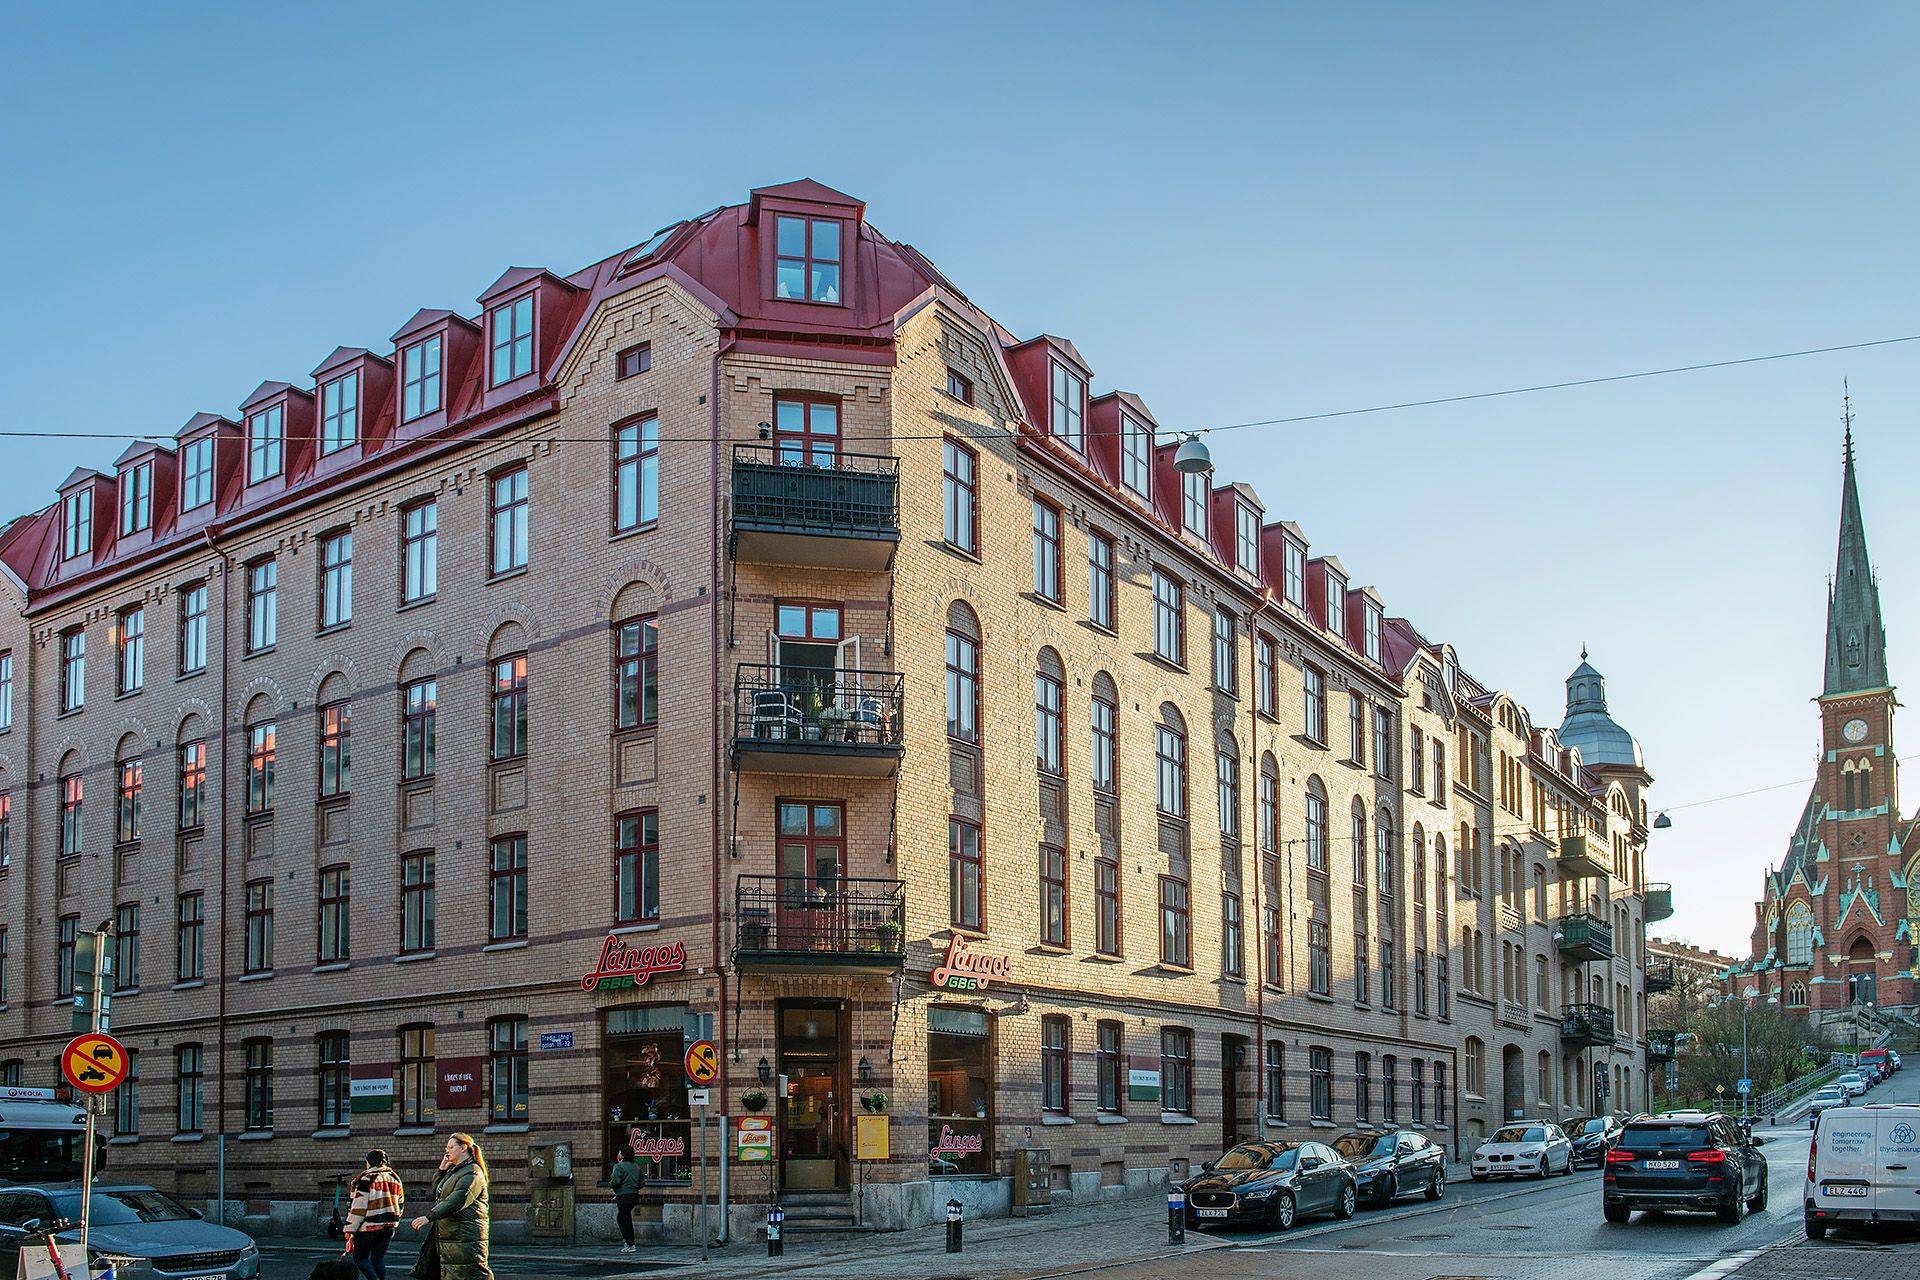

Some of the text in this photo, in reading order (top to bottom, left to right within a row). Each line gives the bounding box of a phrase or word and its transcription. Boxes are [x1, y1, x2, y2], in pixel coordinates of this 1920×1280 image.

[581, 935, 685, 992] Lángos
[932, 934, 1012, 990] Lángos
[600, 976, 634, 990] GBG
[948, 976, 977, 990] GBG
[931, 1125, 982, 1159] Lángos
[940, 1152, 958, 1160] GBG
